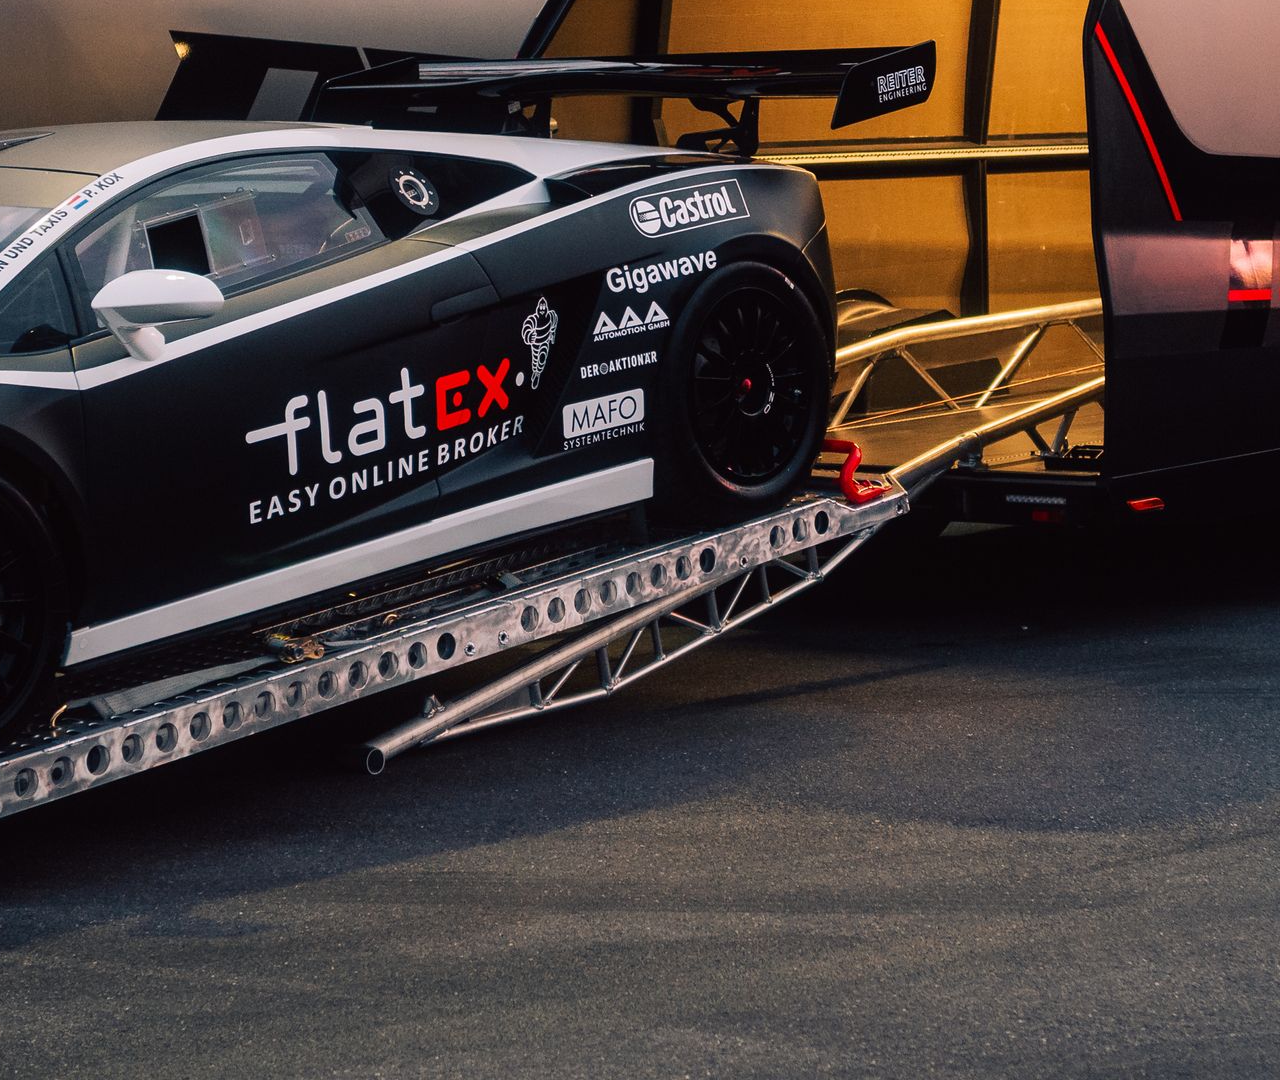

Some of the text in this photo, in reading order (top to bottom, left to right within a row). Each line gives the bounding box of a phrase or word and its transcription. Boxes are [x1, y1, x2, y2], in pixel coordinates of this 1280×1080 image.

[877, 65, 926, 94] REITER
[879, 82, 928, 103] ENGINEERING
[82, 172, 124, 200] P. KOX
[659, 186, 737, 228] Castrol
[4, 237, 34, 260] UND
[29, 209, 68, 238] TAXIS
[606, 250, 717, 294] Gigawave
[593, 320, 671, 343] AUTOMOTION GMBH
[580, 350, 658, 379] DER AKTIONÄR
[571, 396, 637, 433] MAFO
[563, 422, 646, 451] SYSTEMTECHNIK
[249, 415, 524, 524] EASY ONLINE BROKER
